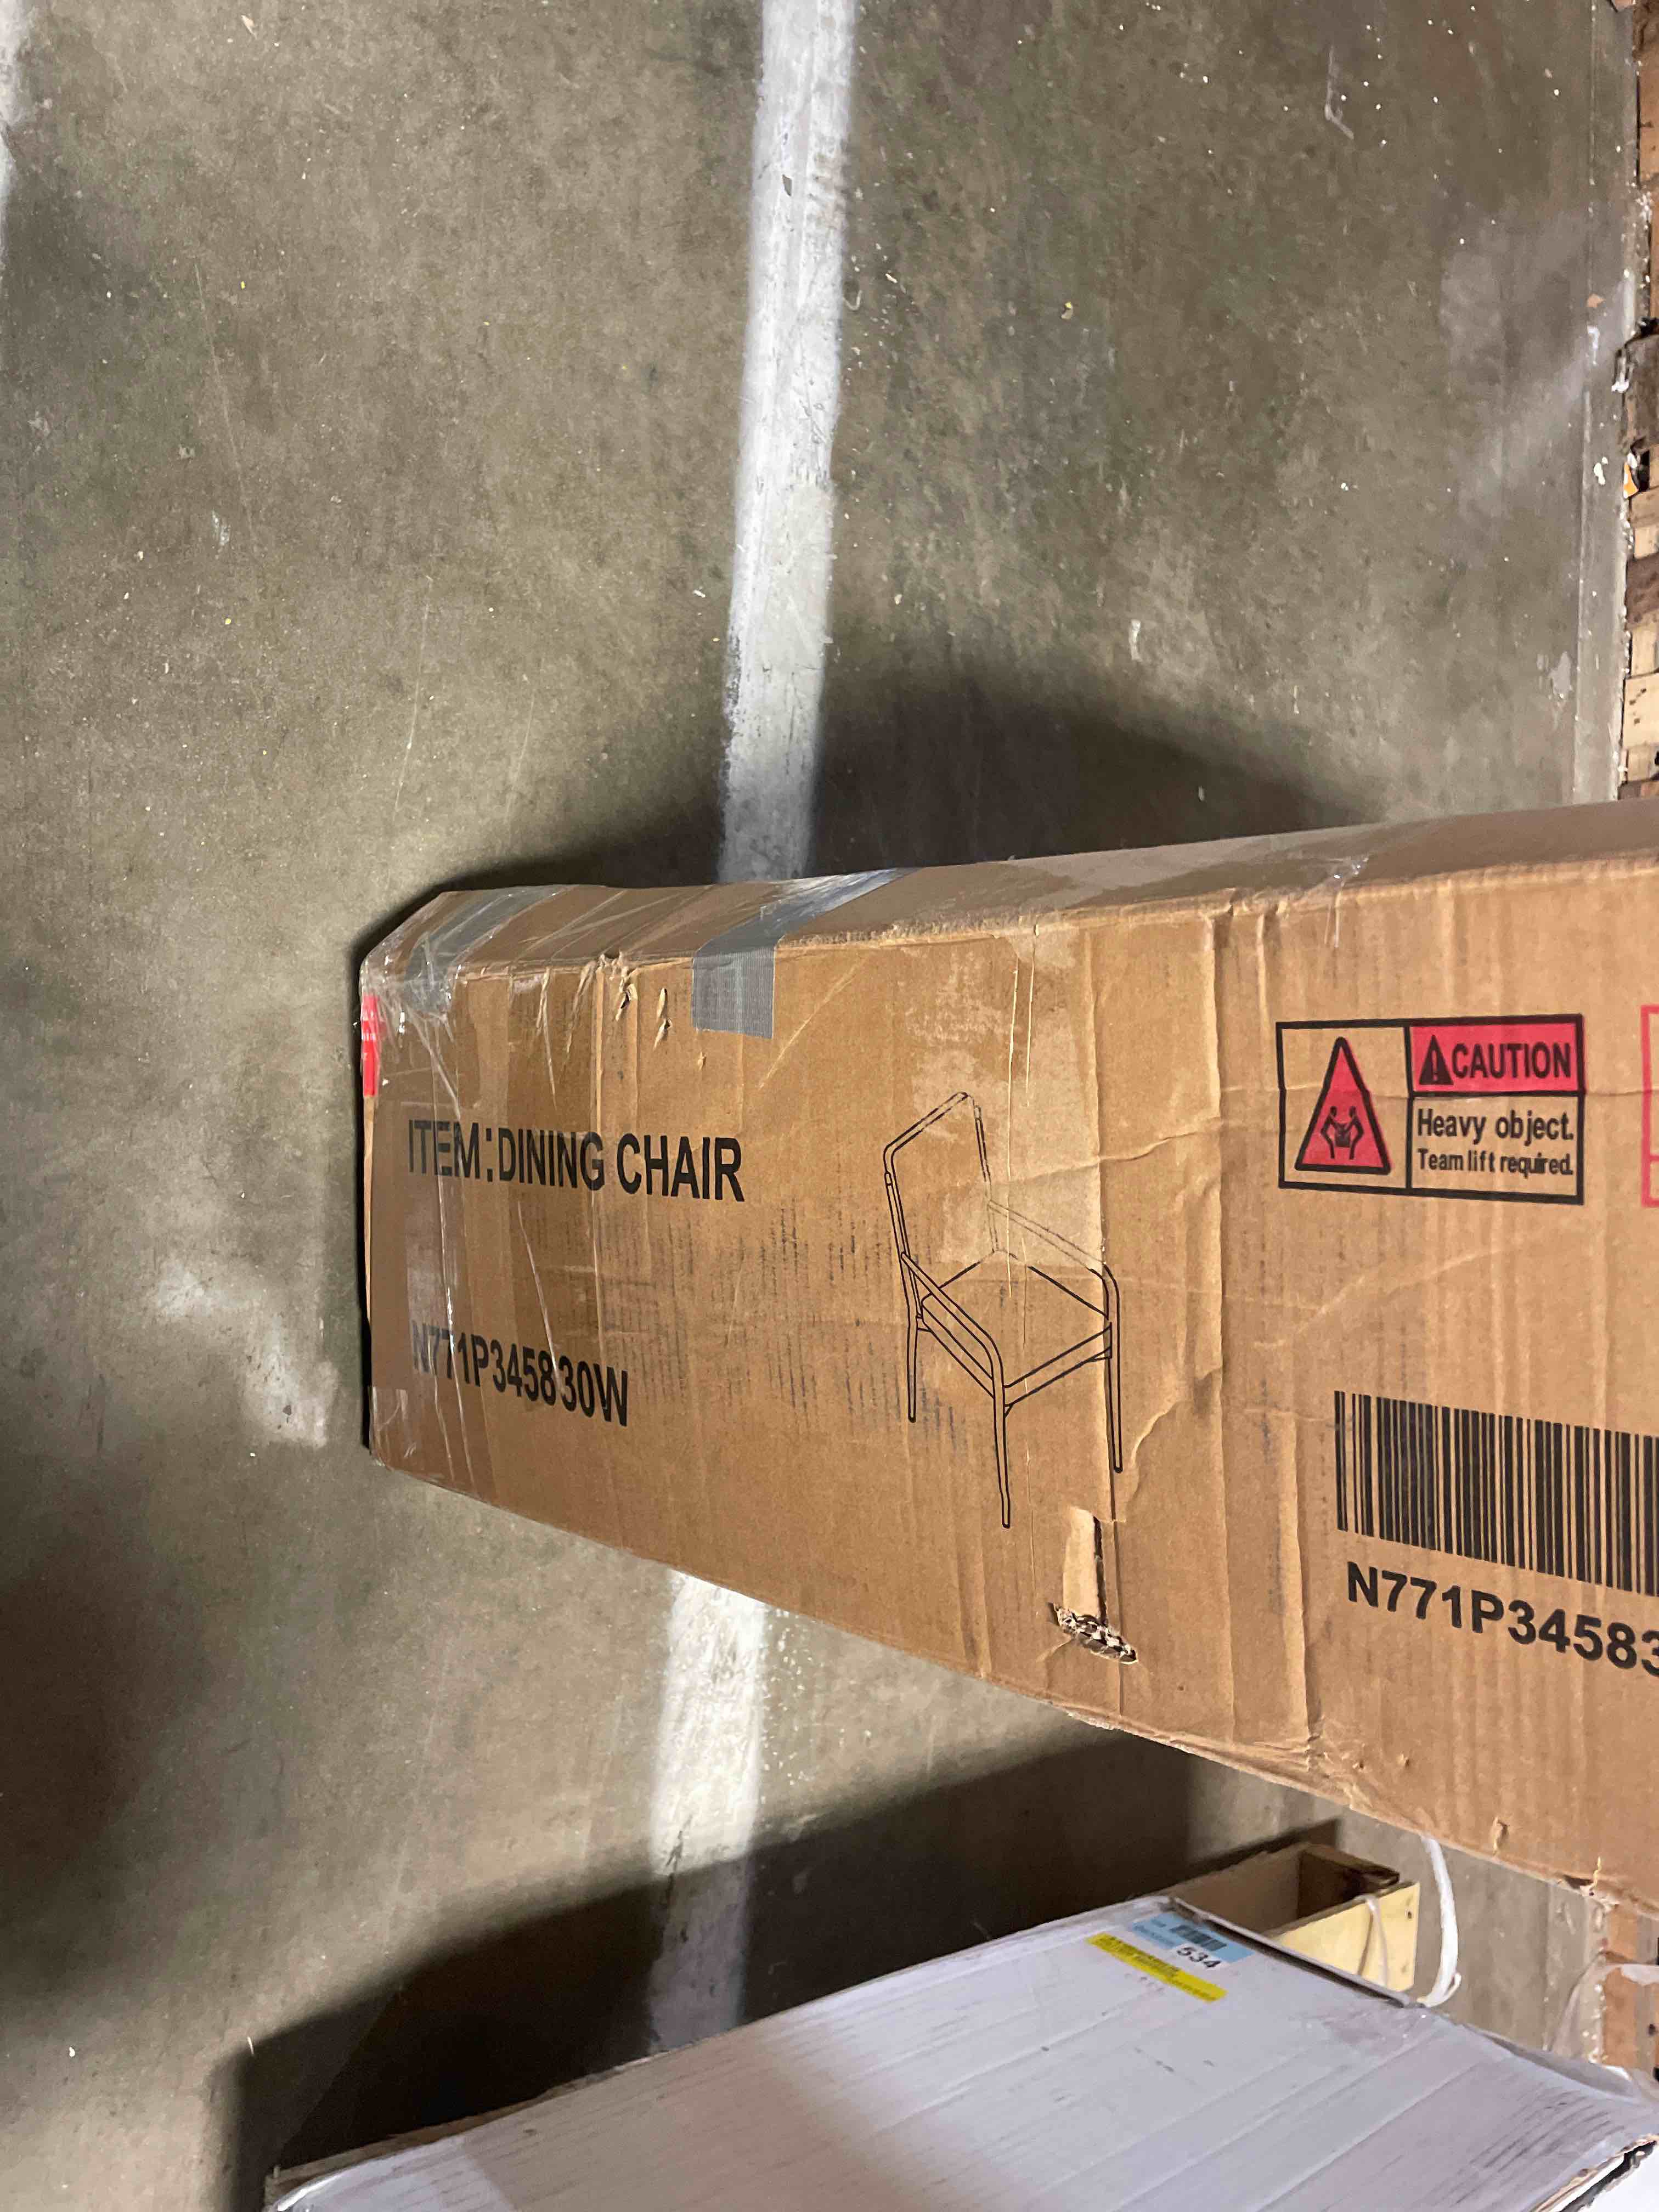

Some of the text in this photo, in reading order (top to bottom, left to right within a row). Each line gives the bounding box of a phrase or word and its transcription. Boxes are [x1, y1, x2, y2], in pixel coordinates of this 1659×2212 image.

[1451, 1042, 1571, 1079] CAUTION
[1417, 1108, 1574, 1147] Heavy object.
[617, 1132, 745, 1202] CHAIR
[1417, 1147, 1573, 1180] Team lift required.
[411, 1319, 628, 1427] N771P345830W
[1176, 1947, 1221, 1968] 534
